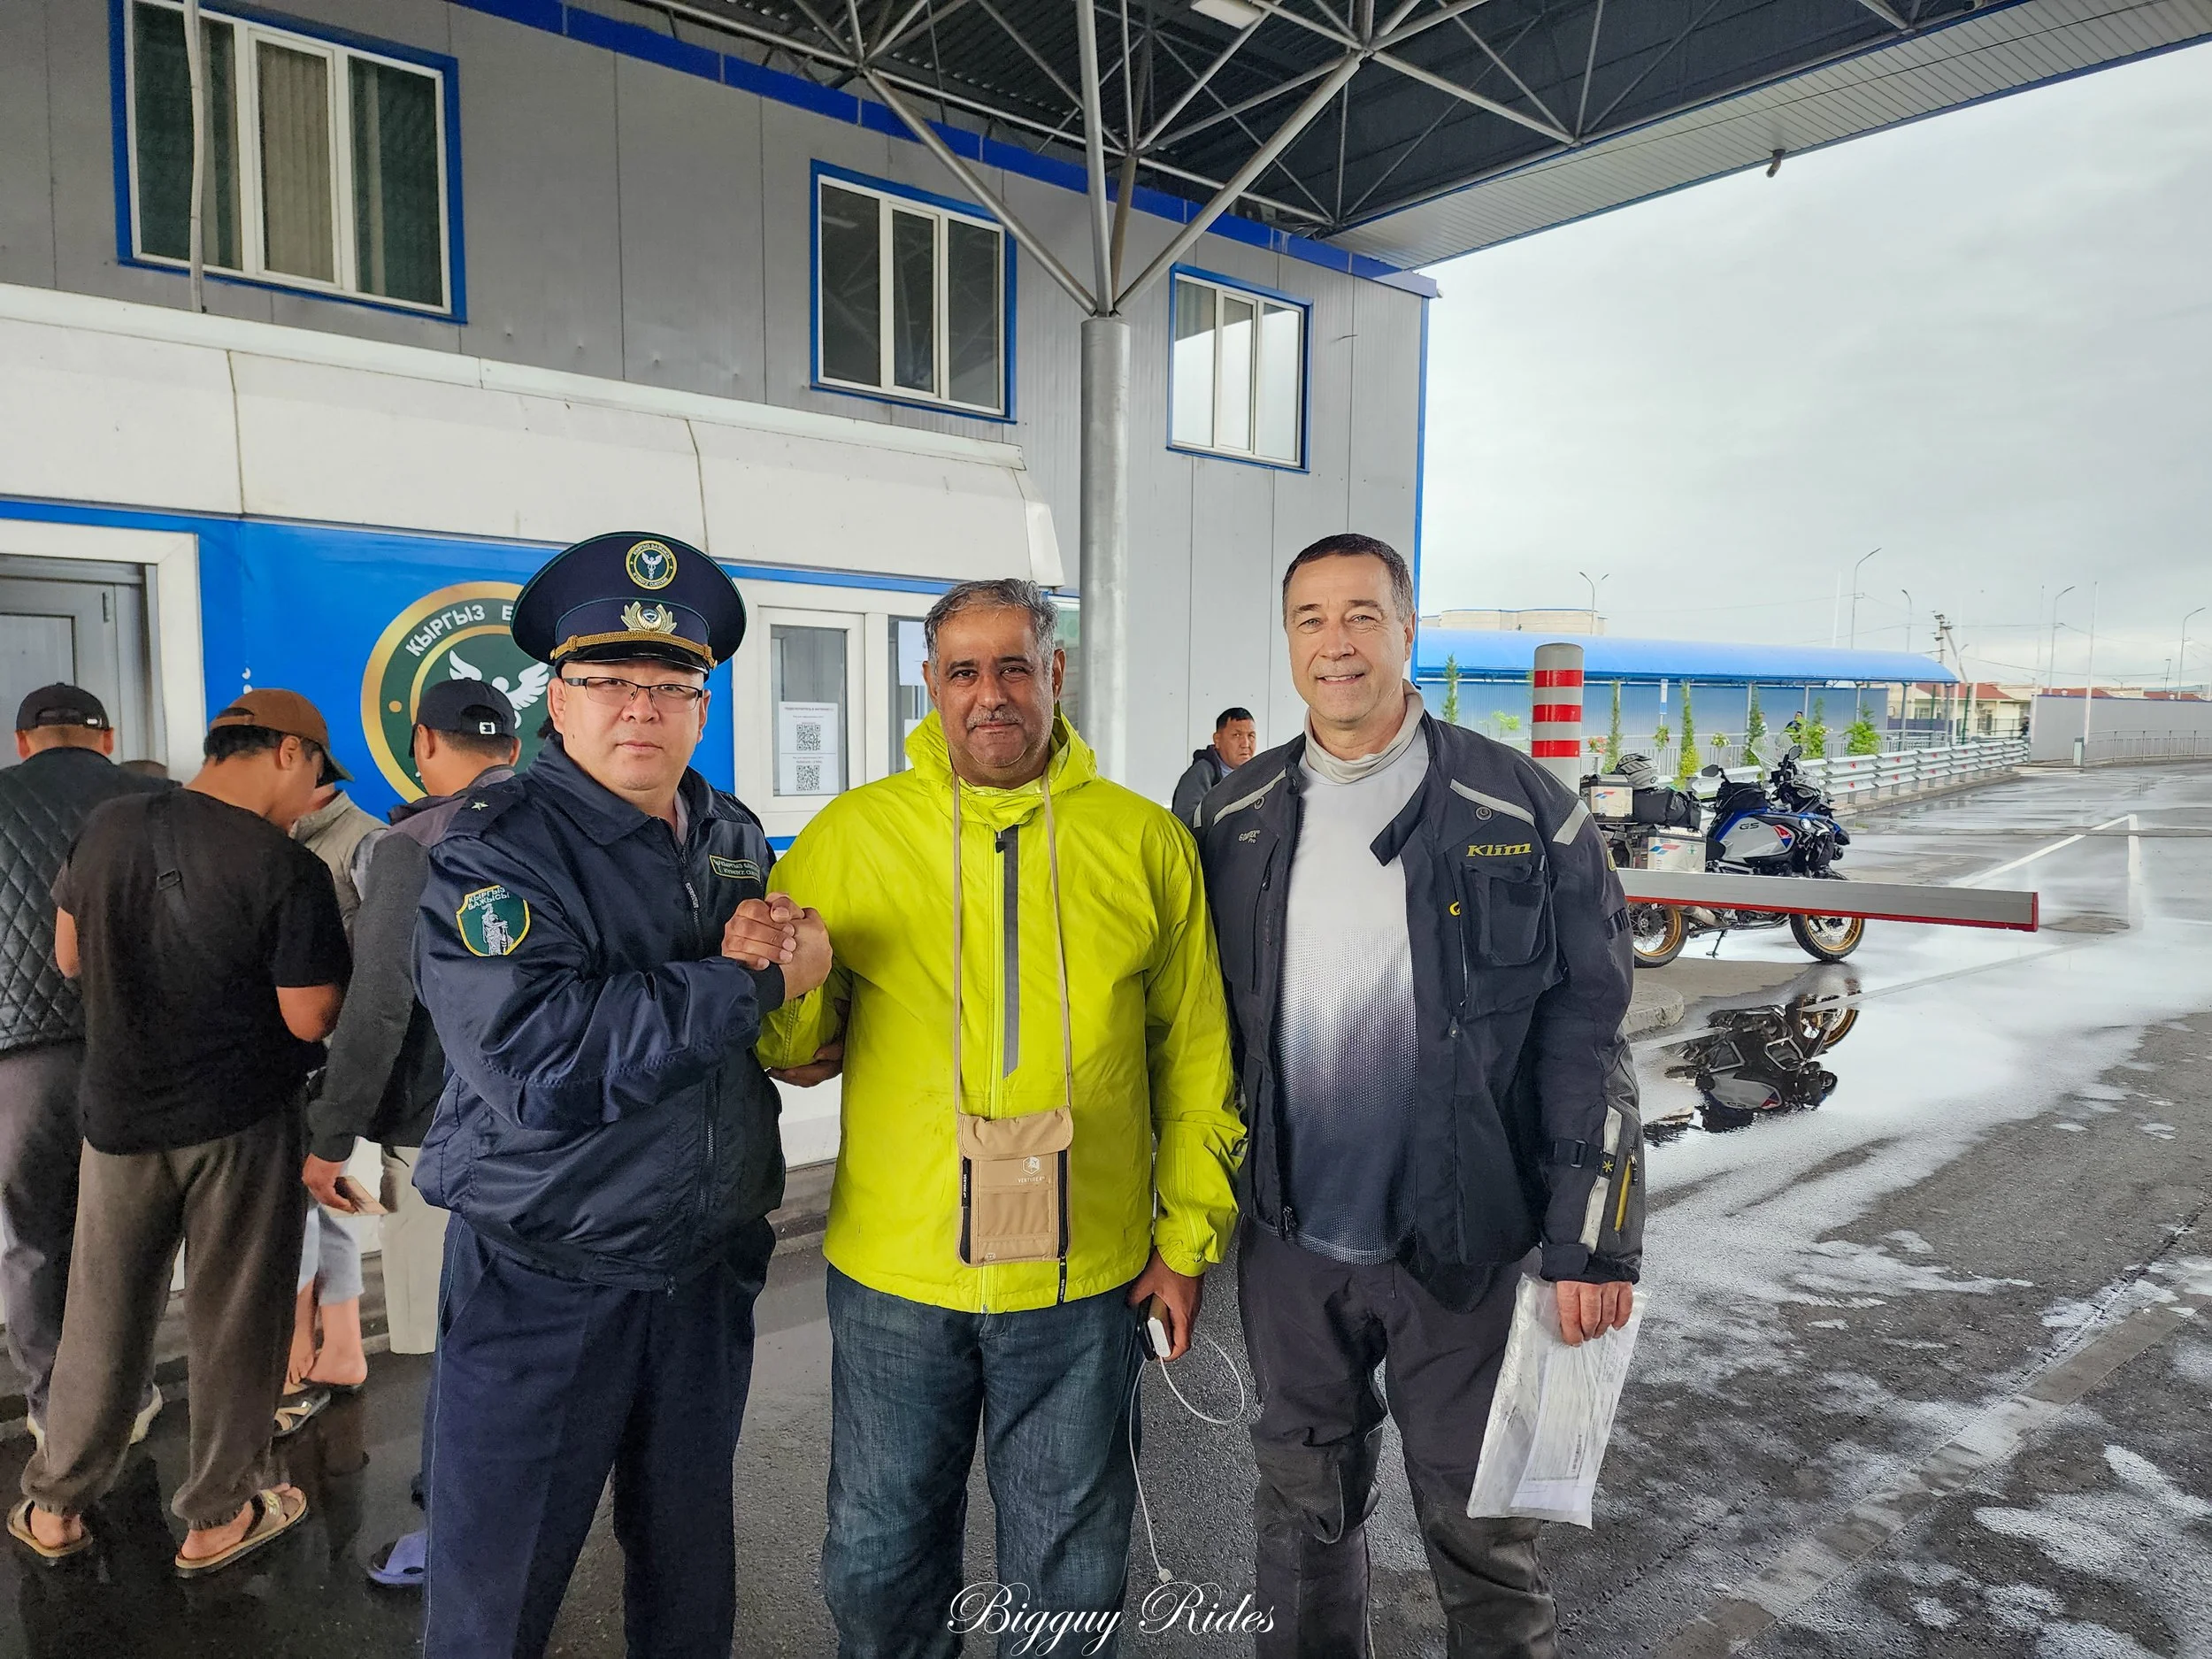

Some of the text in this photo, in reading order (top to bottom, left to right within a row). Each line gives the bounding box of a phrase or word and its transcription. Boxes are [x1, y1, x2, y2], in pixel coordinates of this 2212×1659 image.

[405, 604, 485, 657] КЫРГЫЗ
[1739, 822, 1760, 831] GS
[467, 891, 511, 910] БАЖЫСЫ
[468, 887, 505, 903] КЫРГЫЗ
